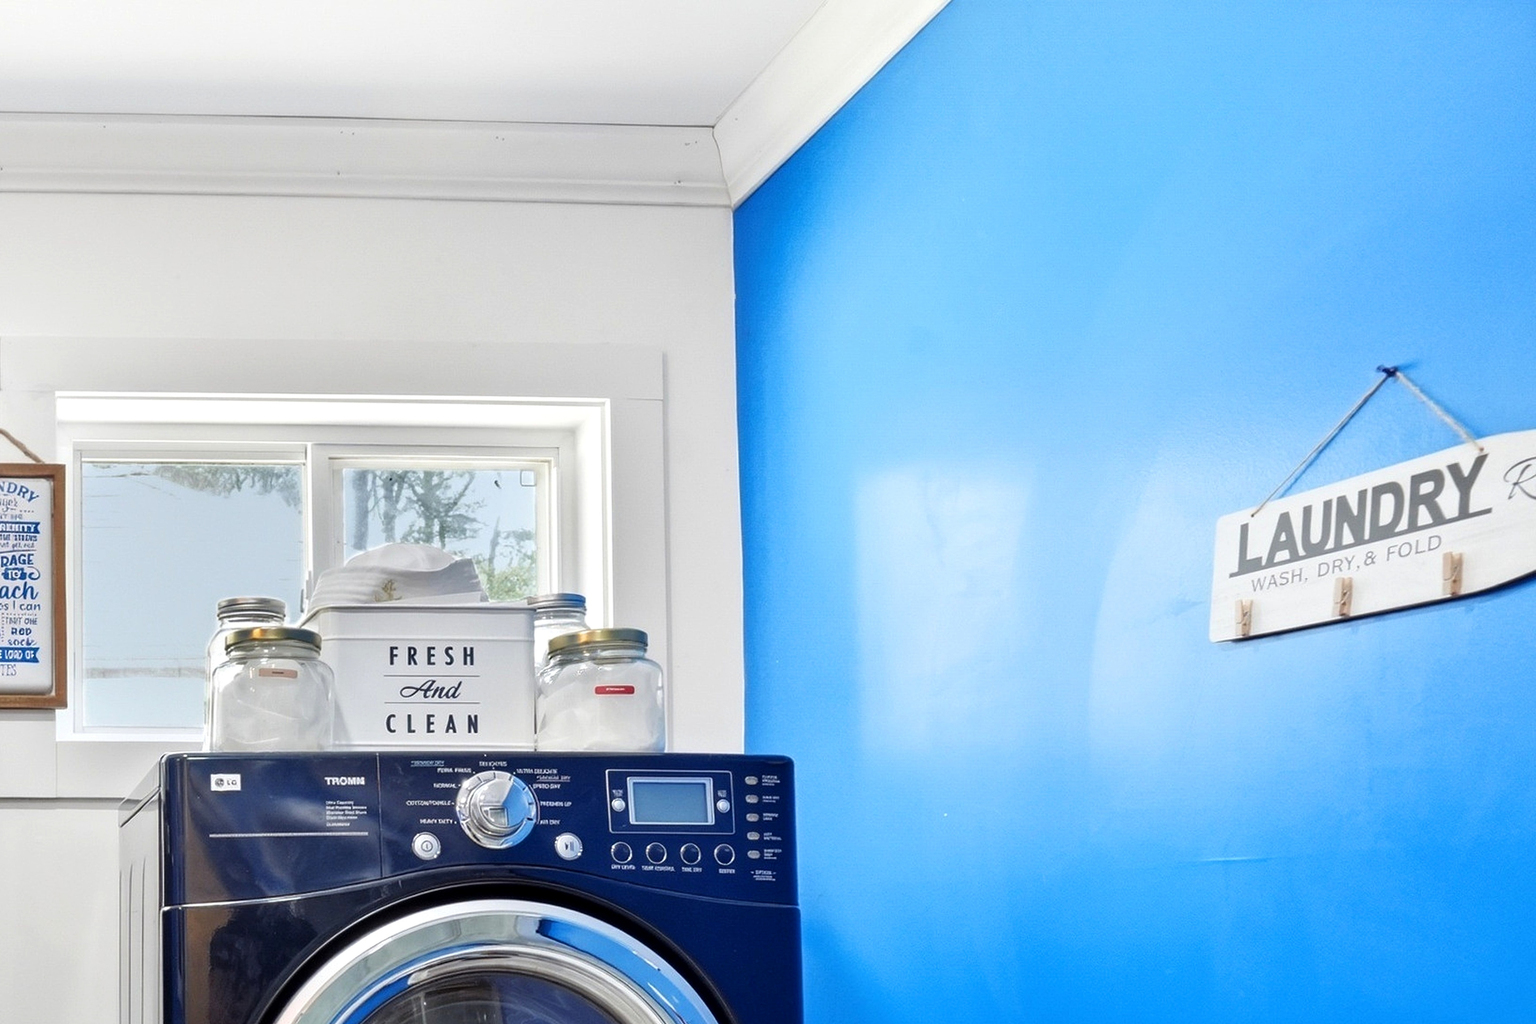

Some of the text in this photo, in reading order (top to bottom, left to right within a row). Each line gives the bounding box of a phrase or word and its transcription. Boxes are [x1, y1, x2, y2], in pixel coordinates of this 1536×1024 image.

[1229, 453, 1492, 578] LAUNDRY
[1251, 535, 1442, 592] WASH, DRY, & FOLD
[19, 603, 41, 612] can
[389, 646, 474, 666] FRESH
[399, 679, 463, 699] And
[386, 714, 479, 734] CLEAN
[324, 776, 366, 786] TROMM
